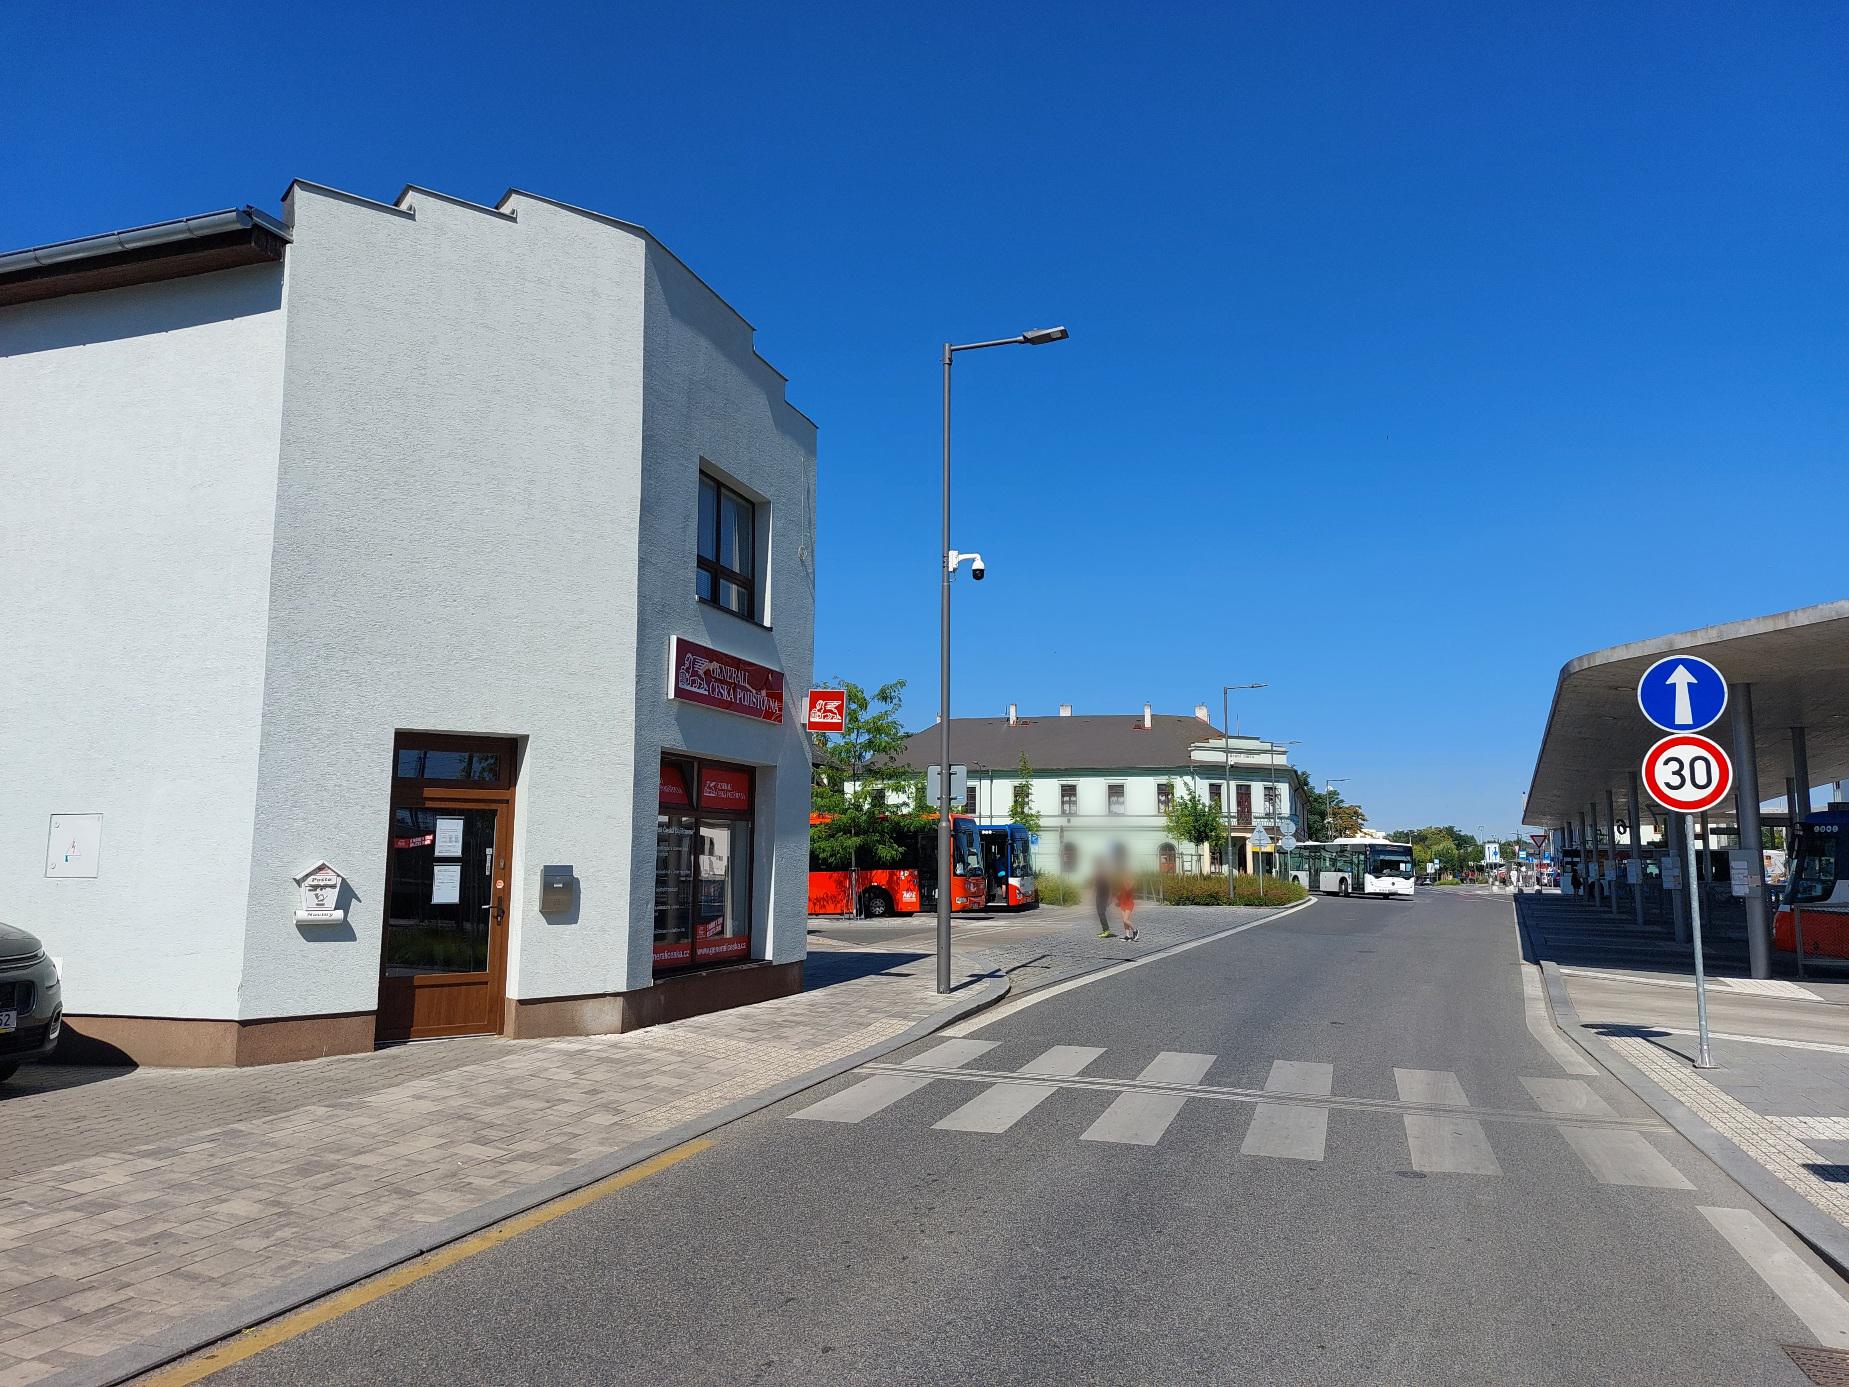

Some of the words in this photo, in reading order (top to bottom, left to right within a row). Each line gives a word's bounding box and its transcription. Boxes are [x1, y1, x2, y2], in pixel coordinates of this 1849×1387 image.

[711, 661, 748, 687] GENERALI
[709, 679, 735, 702] ČESKÁ
[1663, 755, 1712, 790] 30
